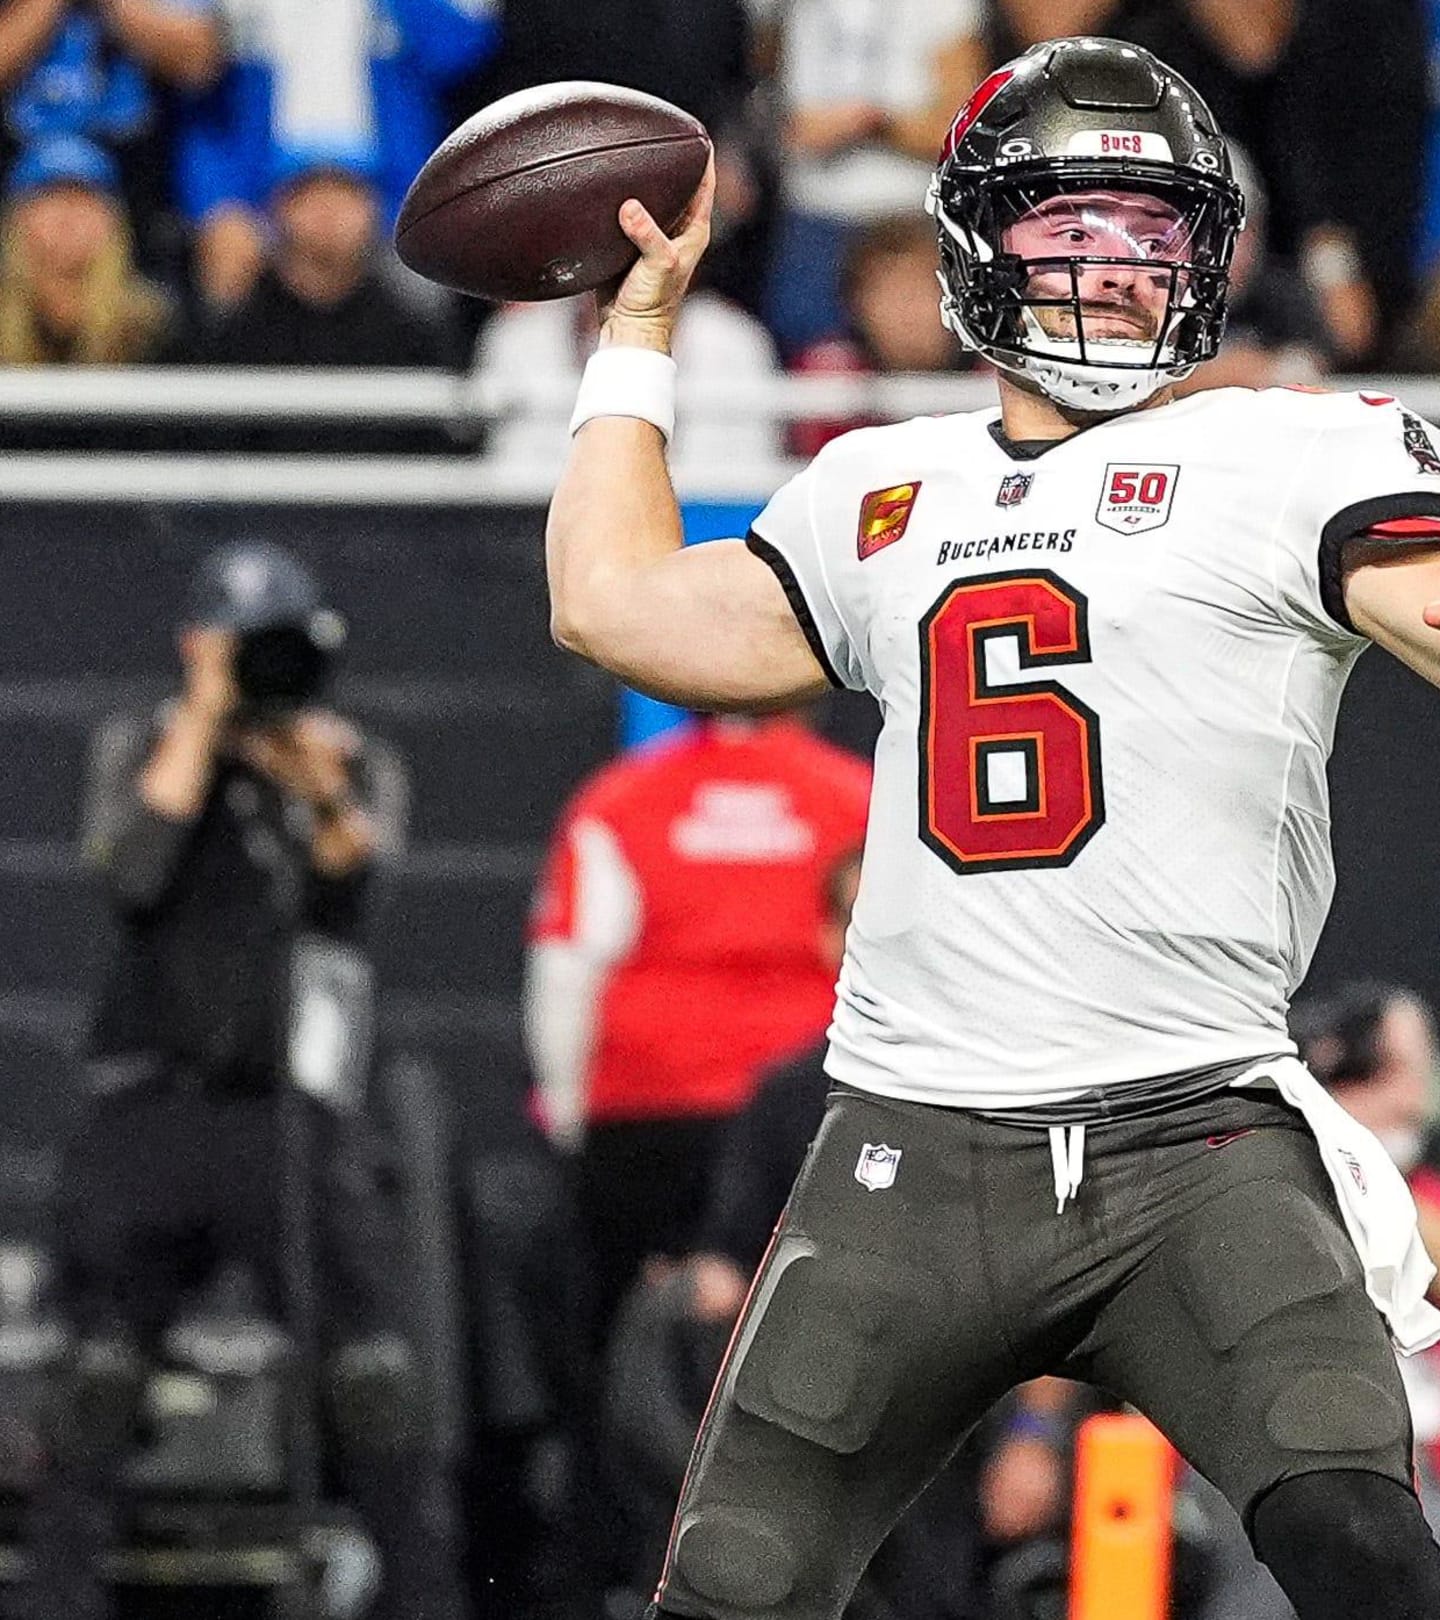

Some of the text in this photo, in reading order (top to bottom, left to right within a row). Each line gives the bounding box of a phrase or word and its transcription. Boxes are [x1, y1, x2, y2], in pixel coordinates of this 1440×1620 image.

[1108, 472, 1168, 505] 50
[936, 529, 1077, 566] BUCCANEERS
[918, 568, 1106, 875] 6
